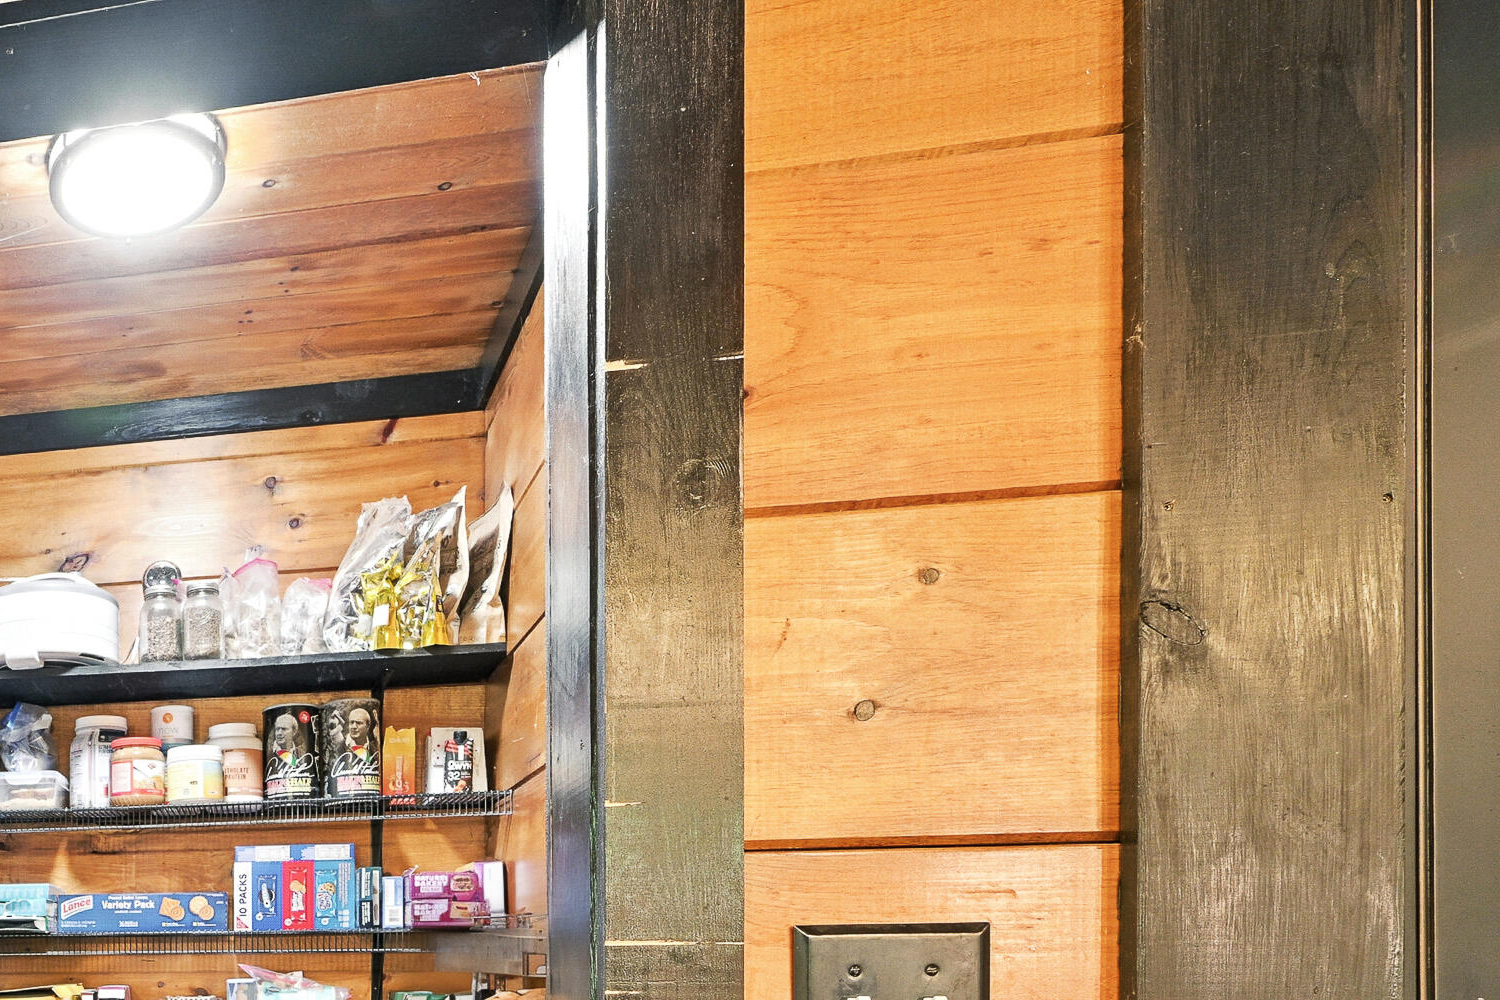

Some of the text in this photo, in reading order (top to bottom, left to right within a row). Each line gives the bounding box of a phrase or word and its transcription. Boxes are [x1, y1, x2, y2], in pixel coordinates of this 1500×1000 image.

[239, 873, 247, 902] PACKS
[63, 898, 92, 914] Lance
[101, 899, 155, 909] Variety Pack
